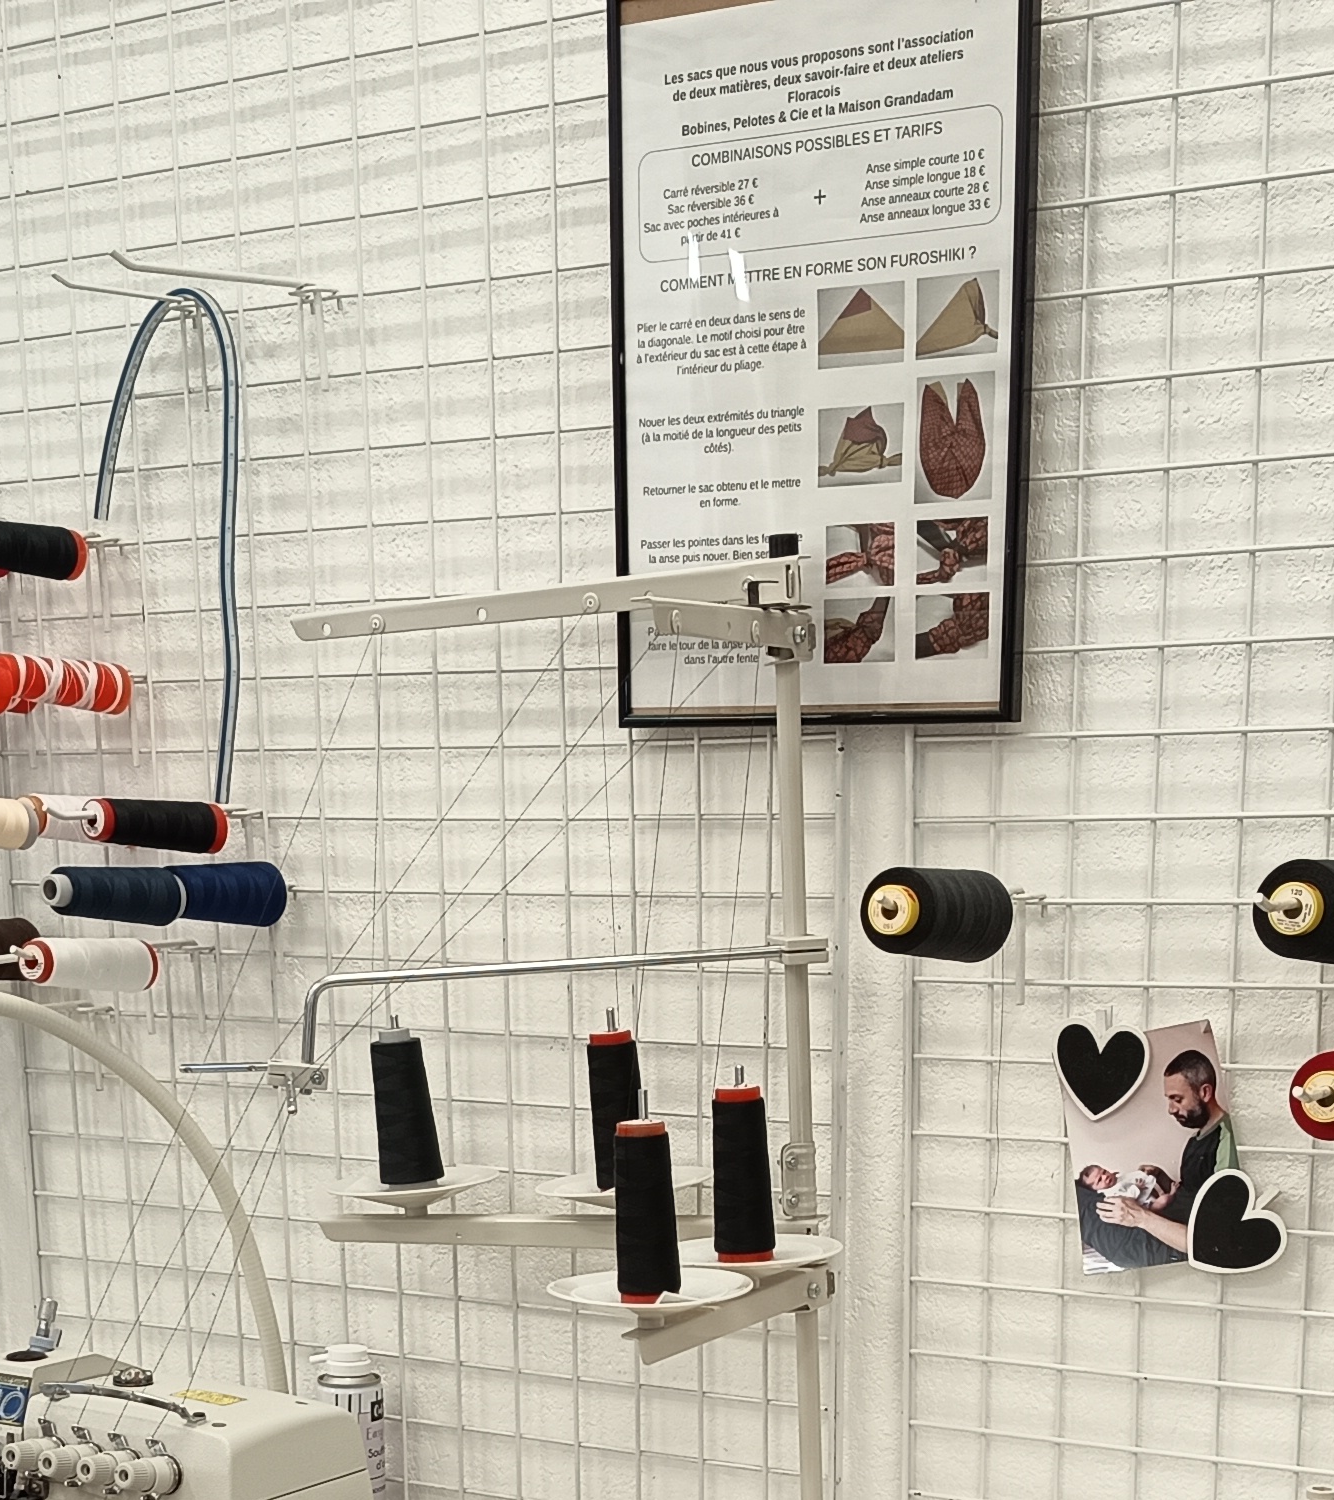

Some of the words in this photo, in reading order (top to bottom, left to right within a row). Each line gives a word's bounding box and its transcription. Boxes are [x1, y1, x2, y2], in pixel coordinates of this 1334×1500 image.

[665, 74, 684, 85] Les
[687, 70, 712, 82] sacs
[716, 66, 736, 80] que
[740, 61, 768, 74] nous
[771, 56, 798, 69] vous
[802, 46, 864, 68] proposons
[868, 40, 894, 54] sont
[898, 28, 973, 50] l'association
[673, 90, 686, 102] de
[689, 87, 716, 99] deux
[720, 79, 770, 95] matières,
[774, 74, 801, 87] deux
[805, 63, 869, 82] savoir-faire
[873, 60, 884, 72] et
[887, 57, 917, 70] deux
[920, 50, 963, 65] ateliers
[788, 85, 840, 103] Floracois
[682, 121, 730, 136] Bobines,
[734, 115, 775, 129] Pelotes
[790, 108, 808, 121] Cie
[812, 106, 822, 118] et
[825, 104, 835, 116] la
[839, 100, 880, 114] Maison
[884, 89, 953, 107] Grandadam
[692, 142, 792, 167] COMBINAISONS
[796, 131, 870, 153] POSSIBLES
[874, 128, 891, 142] ET
[895, 121, 942, 139] TARIFS
[866, 163, 891, 174] Anse
[894, 157, 925, 171] simple
[929, 154, 959, 166] courte
[963, 150, 975, 162] 10
[865, 180, 889, 190] Anse
[893, 174, 924, 187] simple
[927, 171, 960, 184] longue
[964, 166, 976, 178] 18
[663, 186, 688, 199] Carré
[691, 181, 735, 196] réversible
[738, 179, 749, 190] 27
[861, 197, 885, 207] Anse
[889, 192, 931, 204] anneaux
[933, 186, 964, 198] courte
[967, 182, 980, 194] 28
[668, 204, 685, 214] Sac
[687, 198, 731, 212] réversible
[734, 195, 745, 206] 36
[860, 213, 885, 224] Anse
[887, 208, 929, 220] anneaux
[932, 203, 965, 216] longue
[969, 199, 981, 210] 33
[644, 223, 661, 233] Sac
[663, 221, 685, 231] avec
[687, 216, 720, 230] poches
[723, 210, 770, 223] intérieures
[720, 229, 731, 239] 41
[660, 274, 724, 293] COMMENT
[784, 266, 801, 279] EN
[806, 260, 853, 276] FORME
[857, 256, 886, 271] SON
[891, 247, 964, 268] FUROSHIKI
[637, 323, 657, 333] Plier
[709, 316, 731, 327] deux
[733, 314, 755, 324] dans
[769, 311, 791, 320] sens
[793, 308, 805, 318] de
[710, 330, 732, 342] motif
[735, 327, 761, 340] choisi
[764, 327, 784, 339] pour
[690, 349, 701, 359] du
[704, 349, 720, 358] sac
[723, 346, 736, 356] est
[747, 344, 769, 354] cette
[720, 362, 732, 372] du
[639, 418, 665, 427] Nouer
[668, 416, 681, 426] les
[683, 414, 705, 424] deux
[757, 409, 768, 419] du
[771, 406, 804, 419] triangle
[692, 429, 703, 439] de
[716, 427, 755, 439] longueur
[758, 424, 775, 434] des
[778, 423, 802, 436] petits
[643, 486, 686, 496] Retourner
[699, 484, 714, 493] sac
[716, 482, 747, 492] obtenu
[772, 479, 801, 488] mettre
[641, 540, 670, 549] Passer
[673, 538, 685, 548] les
[688, 537, 720, 550] pointes
[722, 536, 744, 546] dans
[746, 534, 759, 544] les
[659, 555, 680, 563] anse
[683, 554, 700, 564] puis
[733, 550, 753, 560] Bien
